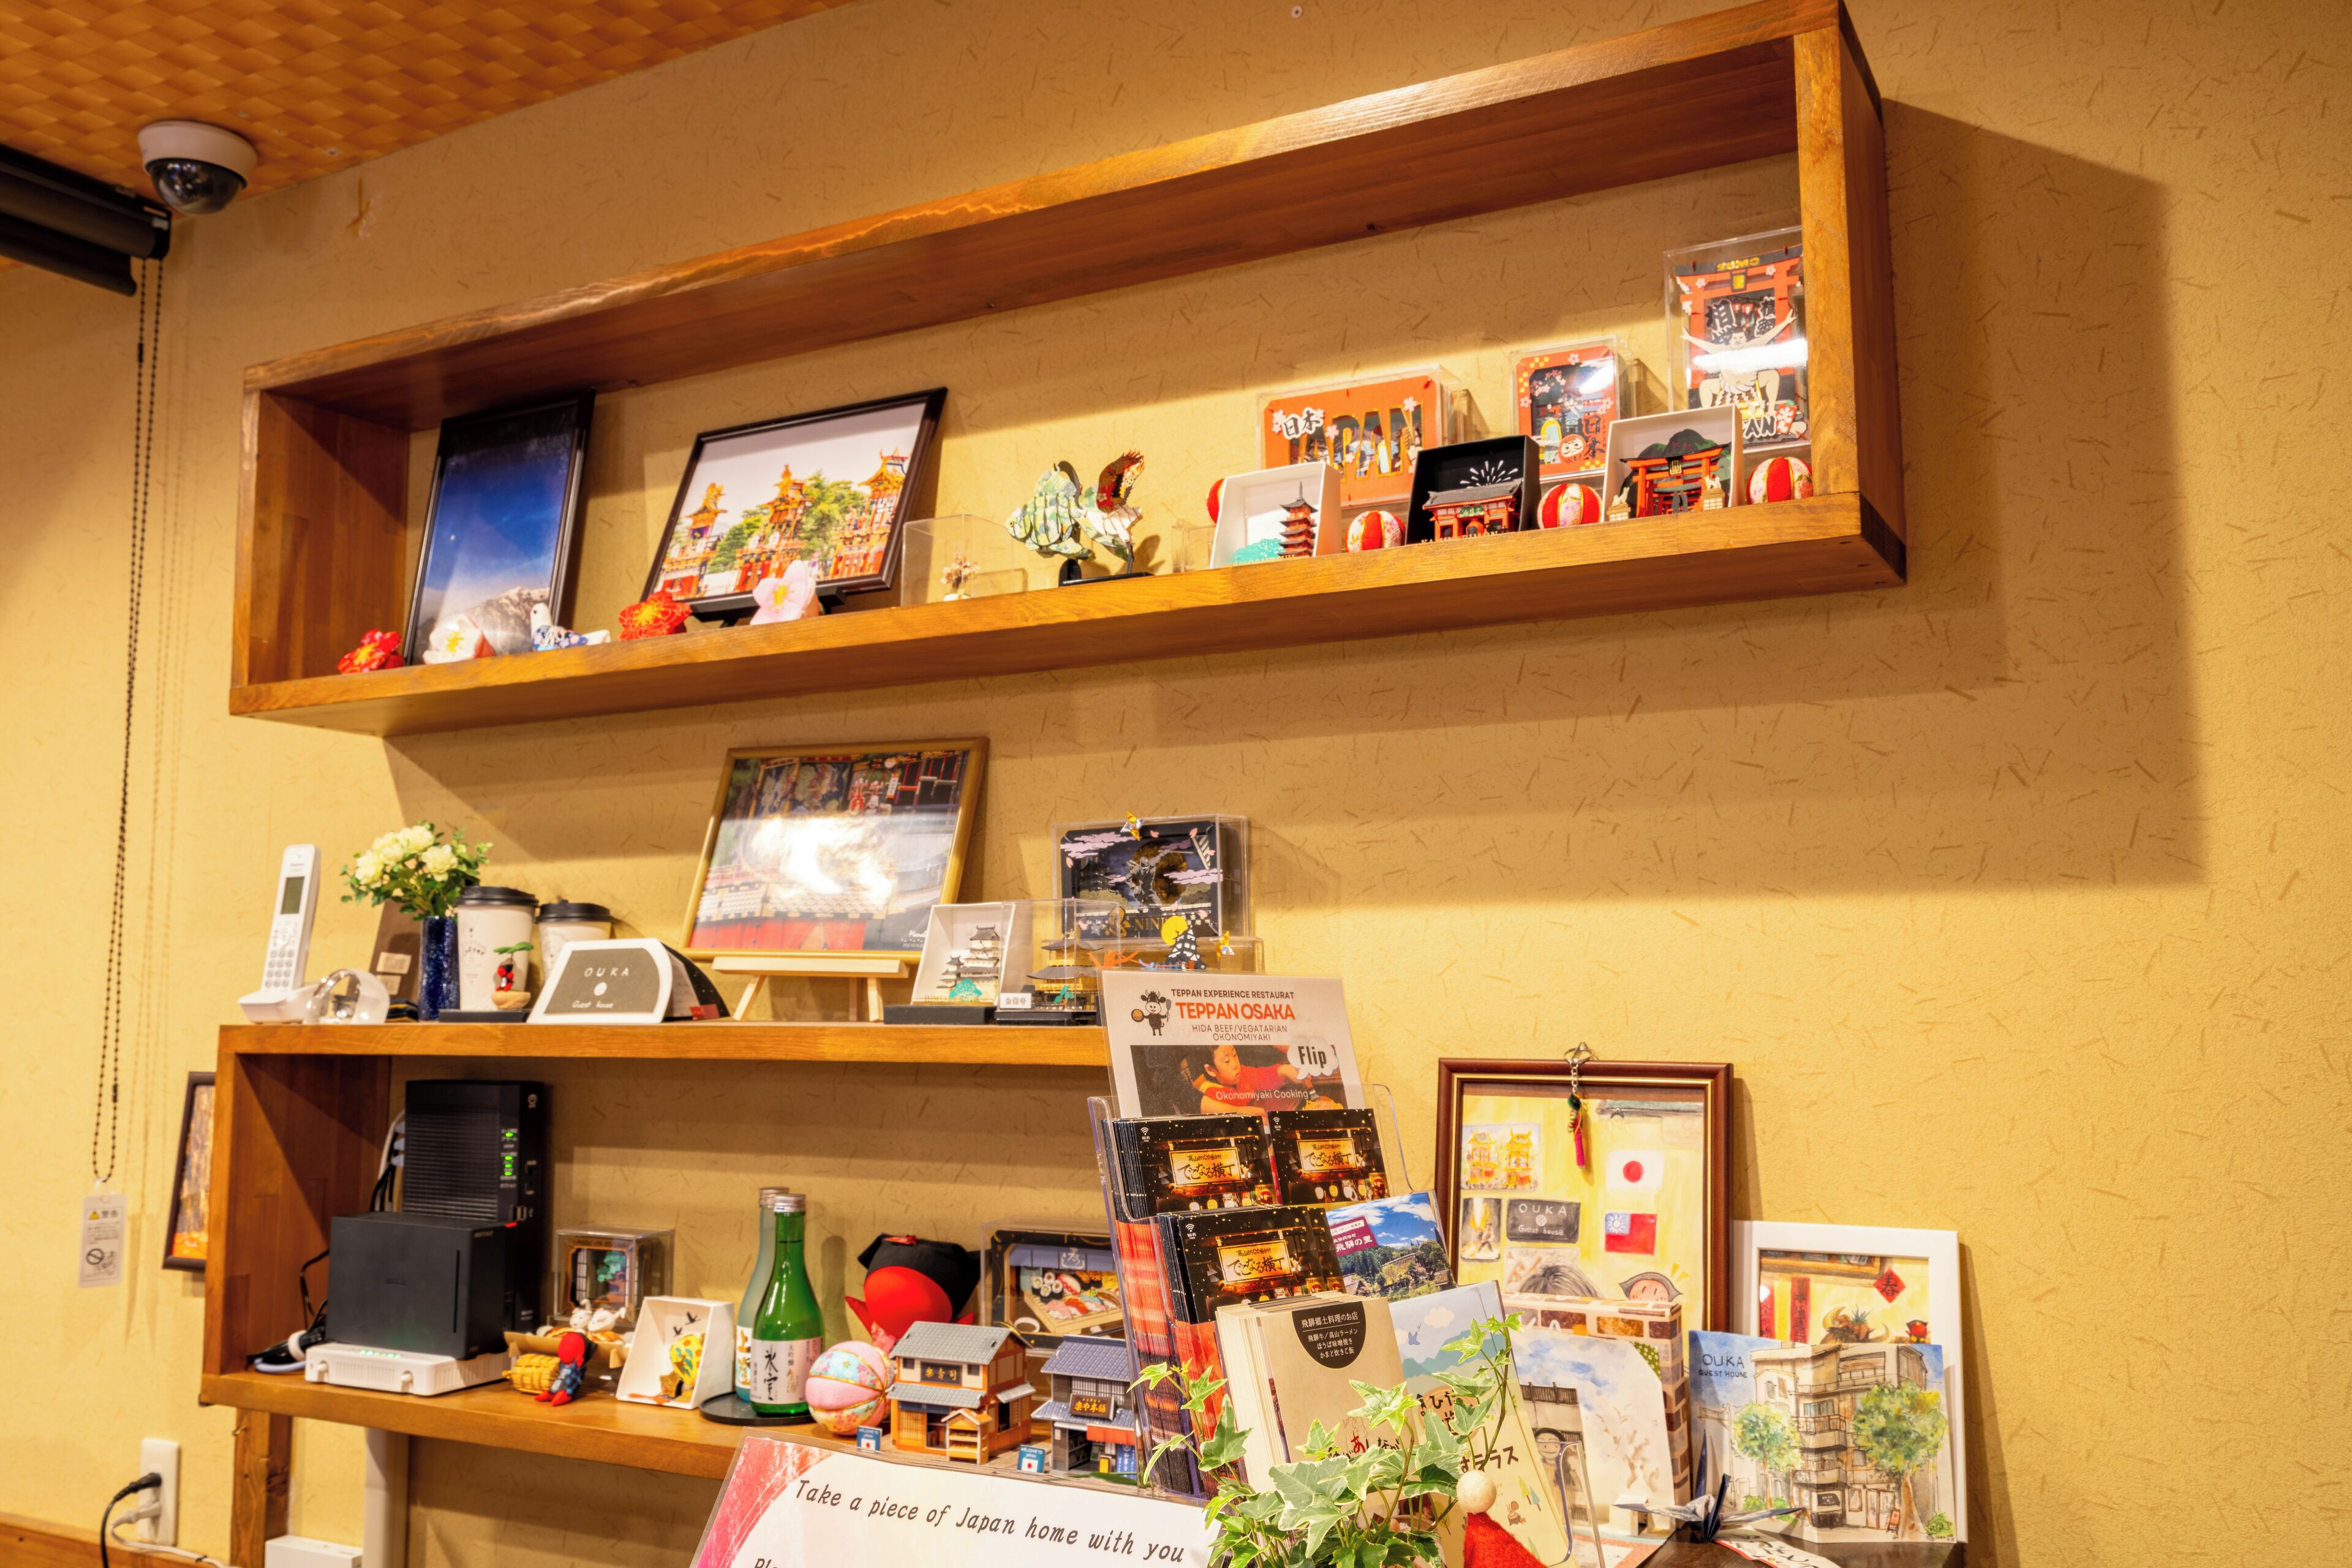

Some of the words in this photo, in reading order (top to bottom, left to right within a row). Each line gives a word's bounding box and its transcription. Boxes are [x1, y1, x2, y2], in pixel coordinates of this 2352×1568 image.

[1716, 257, 1760, 271] SUMO
[1284, 409, 1321, 437] 日本
[1584, 415, 1605, 459] 日本
[584, 967, 630, 978] OUKA
[1171, 989, 1202, 998] TEPPAN
[1204, 990, 1251, 999] EXPERIENCE
[1251, 991, 1294, 1000] RESTAURAT
[572, 1000, 591, 1009] Guest
[596, 1000, 614, 1009] house
[1175, 1002, 1240, 1020] TEPPAN
[1241, 1003, 1296, 1020] OSAKA
[1215, 1023, 1287, 1033] BEEF/VEGATARIAN
[1213, 1033, 1271, 1042] OKONOMIYAKI
[1297, 1046, 1327, 1069] Flip
[1216, 1089, 1273, 1102] Okonomiyaki
[1273, 1088, 1309, 1101] Cooking
[1304, 1152, 1352, 1167] でこなる横丁
[1177, 1162, 1235, 1180] でこなる横丁
[1519, 1204, 1567, 1216] OUKA
[1518, 1224, 1539, 1234] Guest
[1336, 1235, 1373, 1252] 飛騨の里
[1226, 1257, 1285, 1276] でこなる横丁
[1881, 1275, 1899, 1297] 春
[1302, 1311, 1359, 1329] 飛騨郷土料理のお店
[1702, 1354, 1744, 1368] OUKA
[1698, 1369, 1722, 1378] GUEST
[1725, 1370, 1747, 1379] HOUSE
[796, 1479, 842, 1506] Take
[850, 1496, 862, 1511] a
[867, 1496, 919, 1521] piece
[926, 1505, 951, 1527] of
[956, 1507, 1015, 1535] Japan
[1025, 1516, 1079, 1545] home
[1088, 1529, 1133, 1555] with
[1143, 1543, 1185, 1563] you
